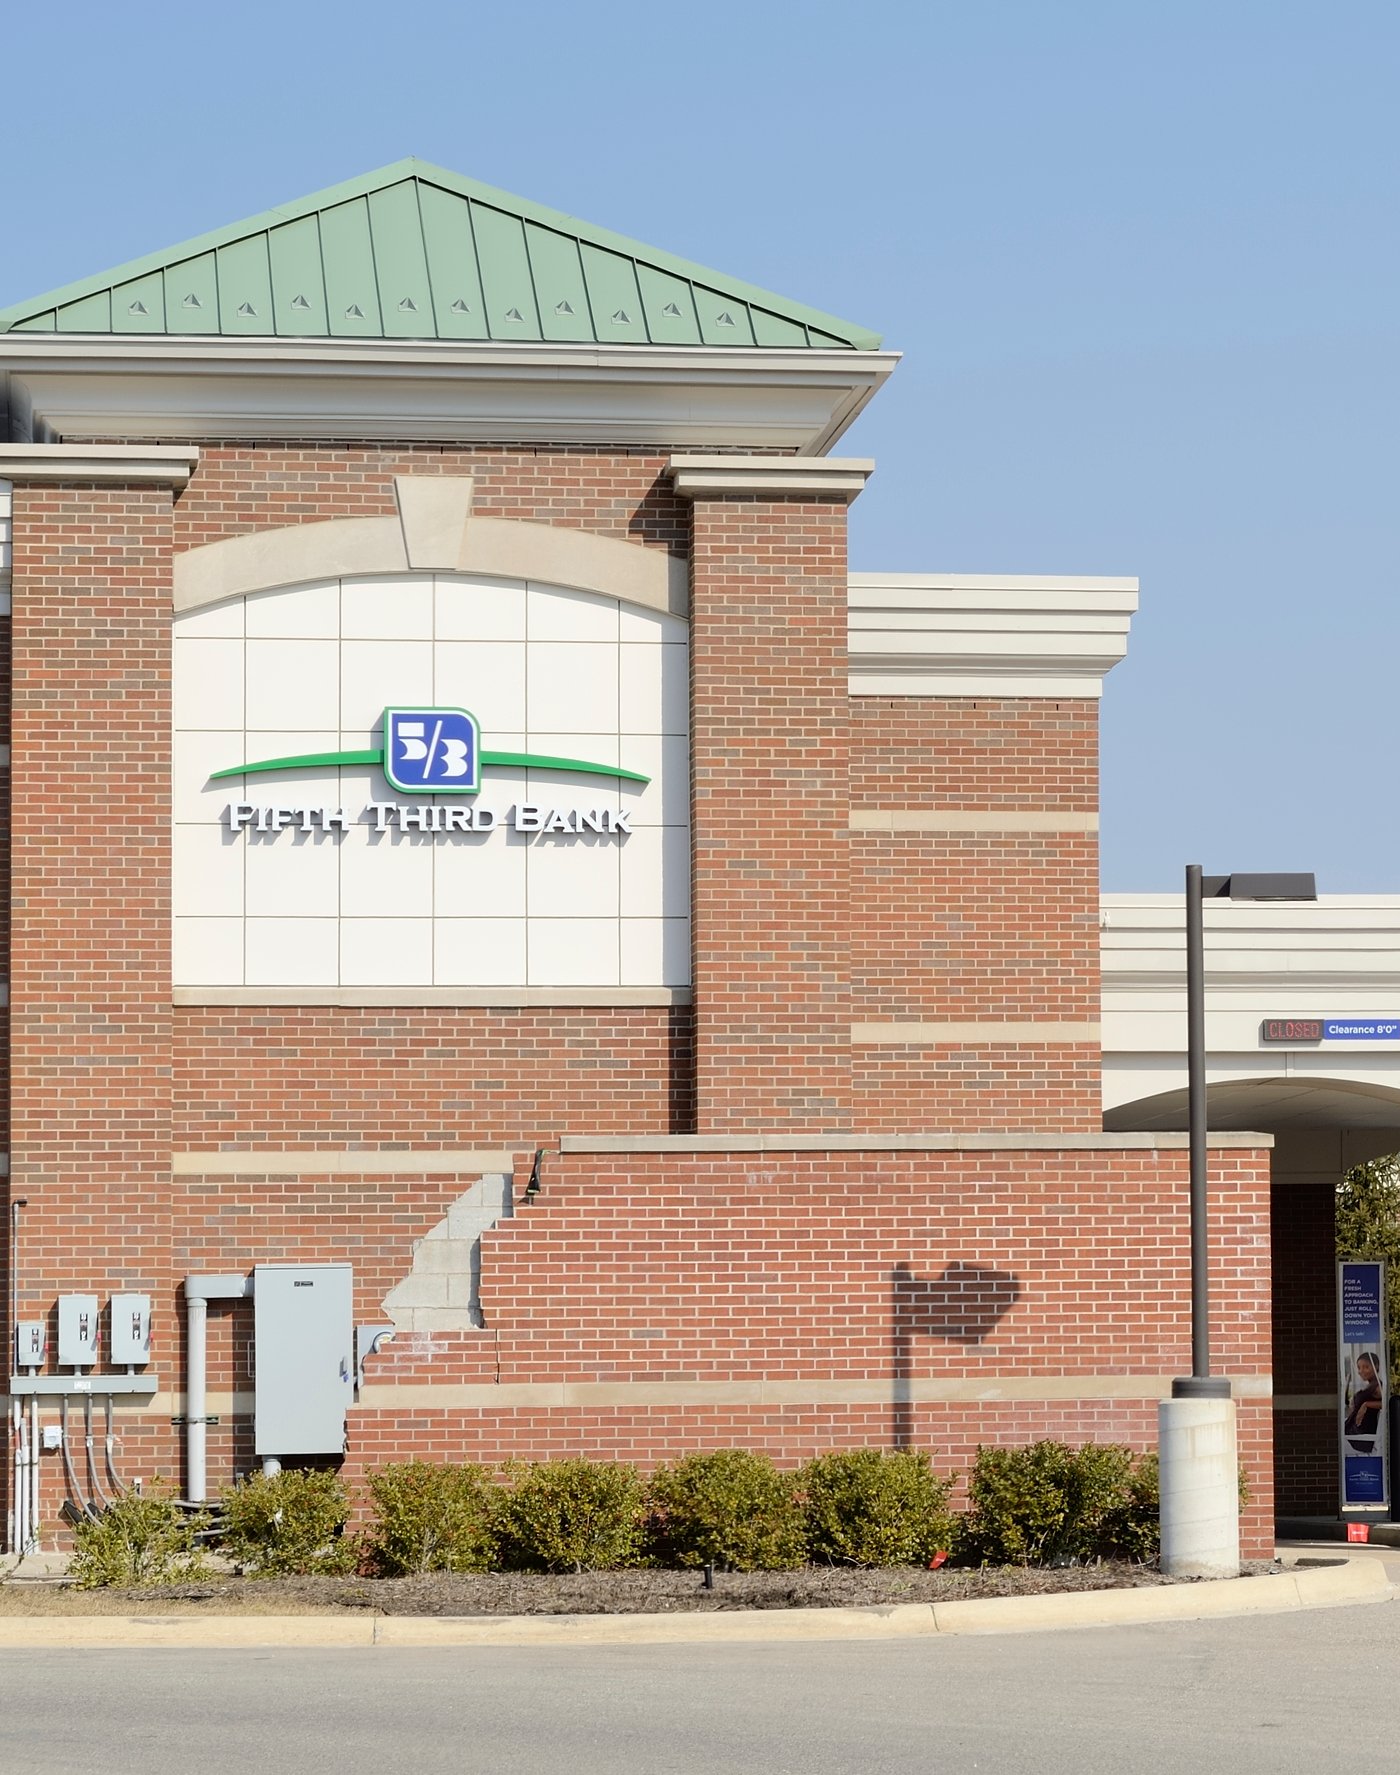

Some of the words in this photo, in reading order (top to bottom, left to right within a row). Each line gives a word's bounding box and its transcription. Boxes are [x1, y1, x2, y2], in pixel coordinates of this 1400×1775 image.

[230, 801, 350, 832] FIFTH
[366, 801, 496, 832] THIRD
[514, 802, 632, 834] BANK
[1270, 1022, 1320, 1038] CLOSED
[1328, 1025, 1374, 1034] Clearance
